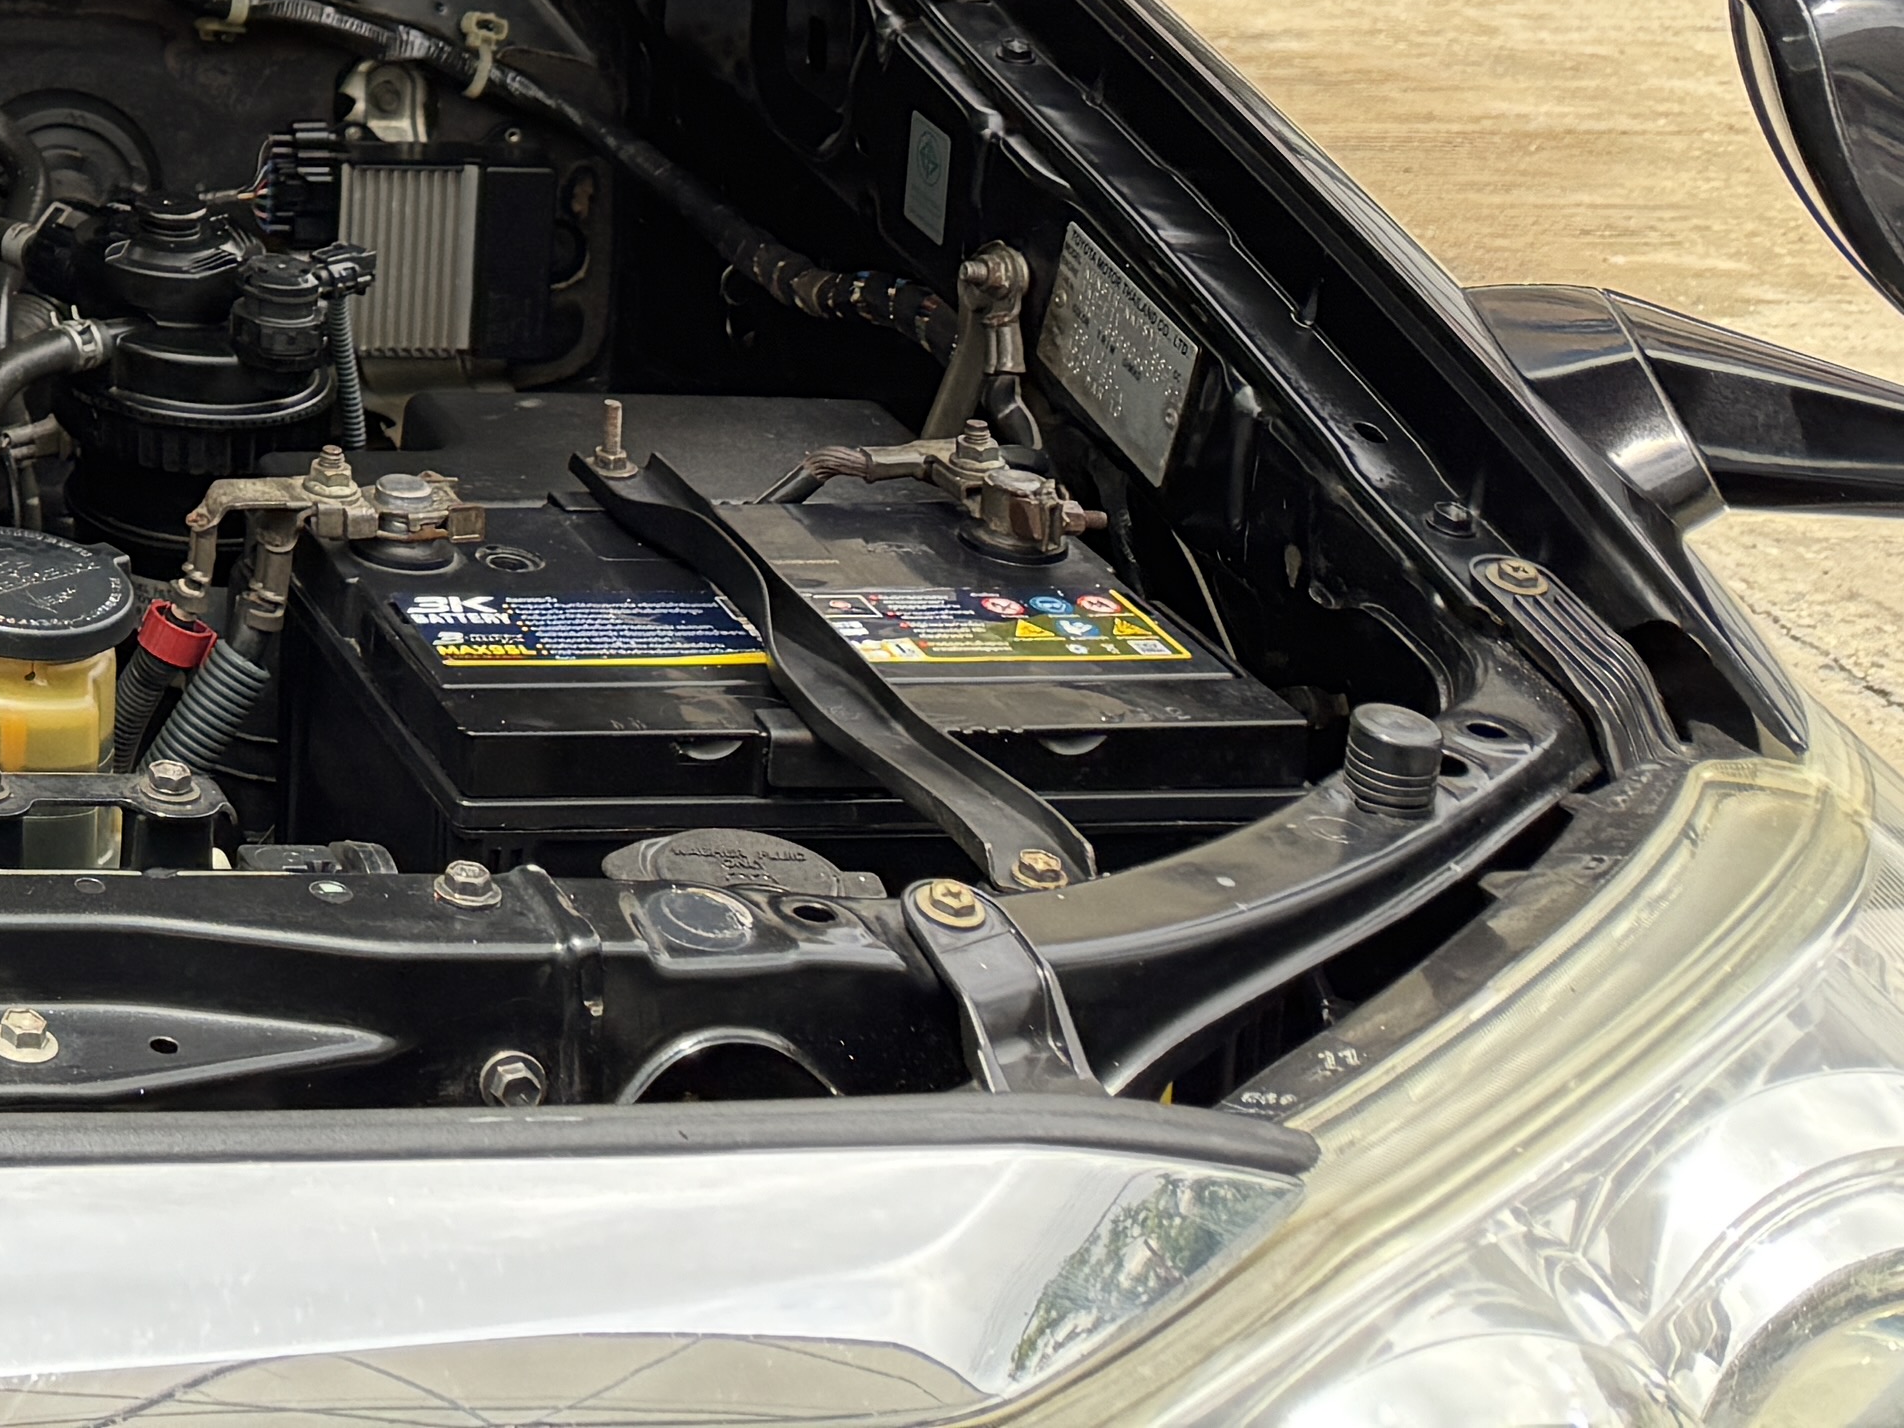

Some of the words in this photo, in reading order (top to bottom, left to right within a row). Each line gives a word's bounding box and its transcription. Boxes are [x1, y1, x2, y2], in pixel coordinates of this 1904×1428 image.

[1070, 228, 1097, 264] TOYOTA
[407, 596, 497, 614] 3K
[410, 612, 511, 625] BATTERY
